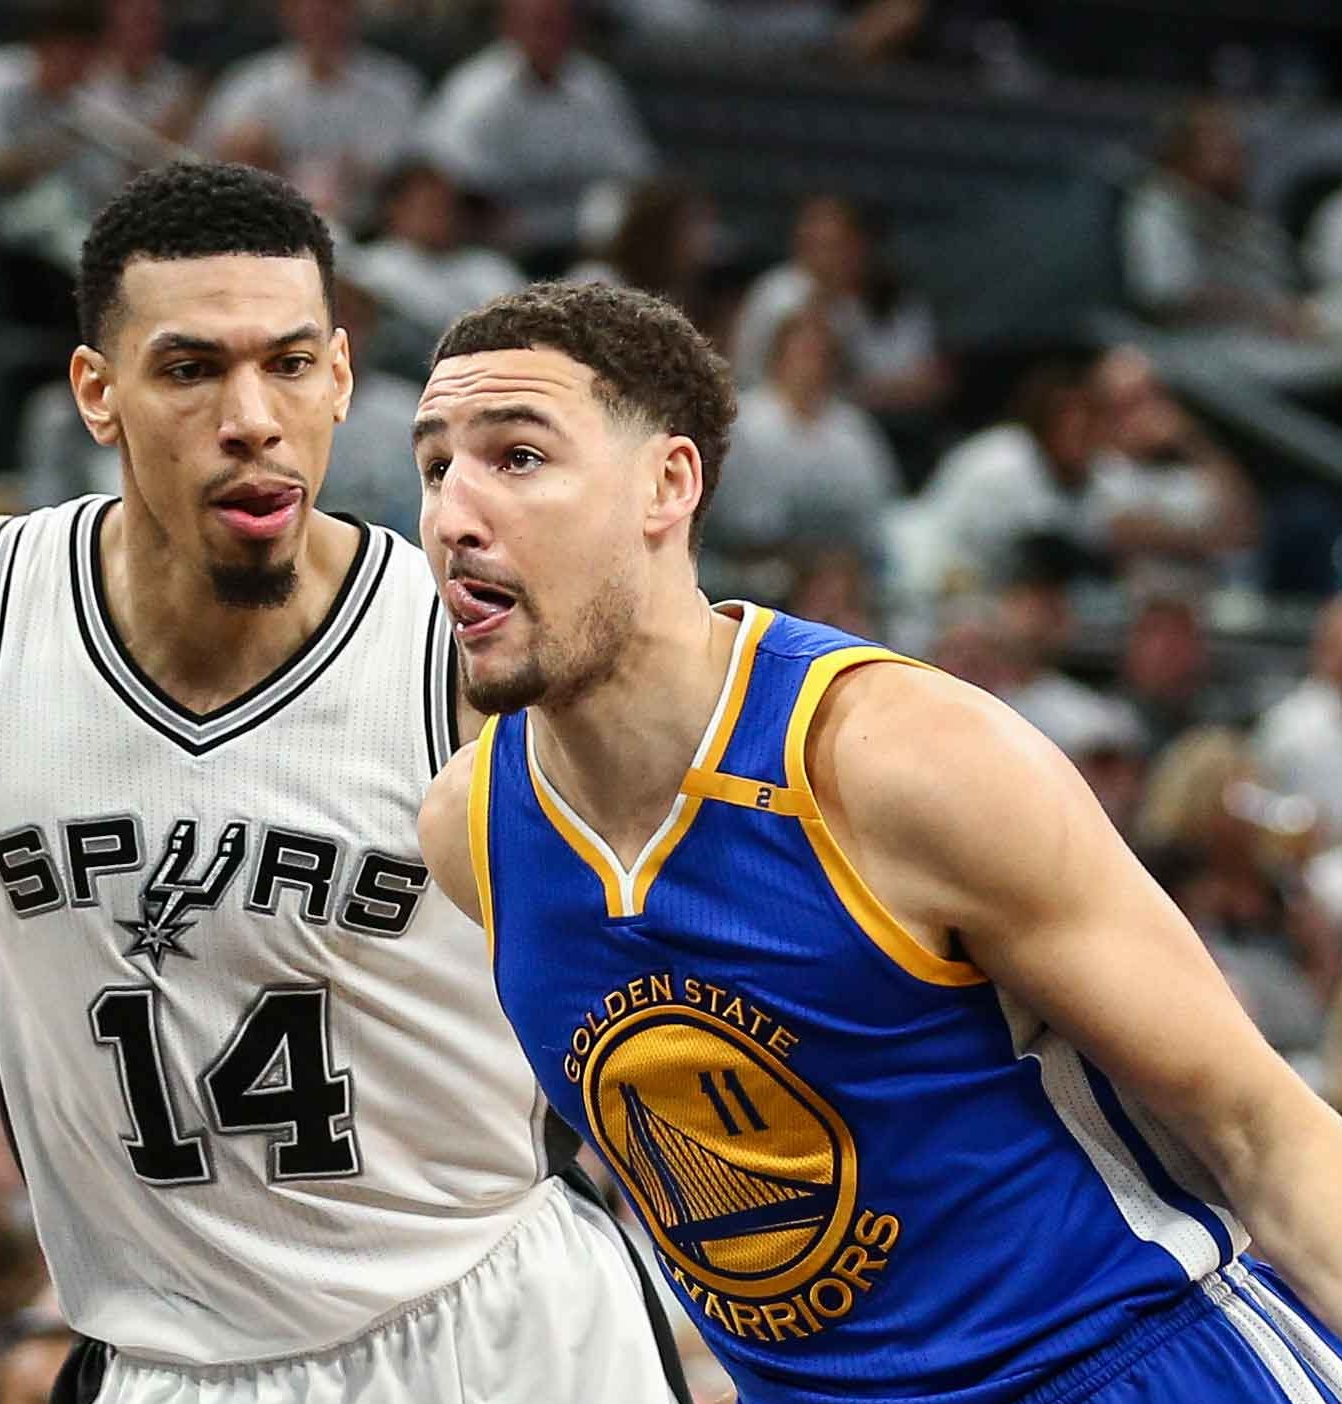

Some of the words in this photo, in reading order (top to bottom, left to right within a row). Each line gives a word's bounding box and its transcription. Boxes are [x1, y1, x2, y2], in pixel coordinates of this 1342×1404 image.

[756, 787, 772, 808] 2
[564, 974, 673, 1083] GOLDEN
[684, 978, 799, 1058] STATE
[88, 984, 360, 1186] 14
[698, 1068, 770, 1137] 11
